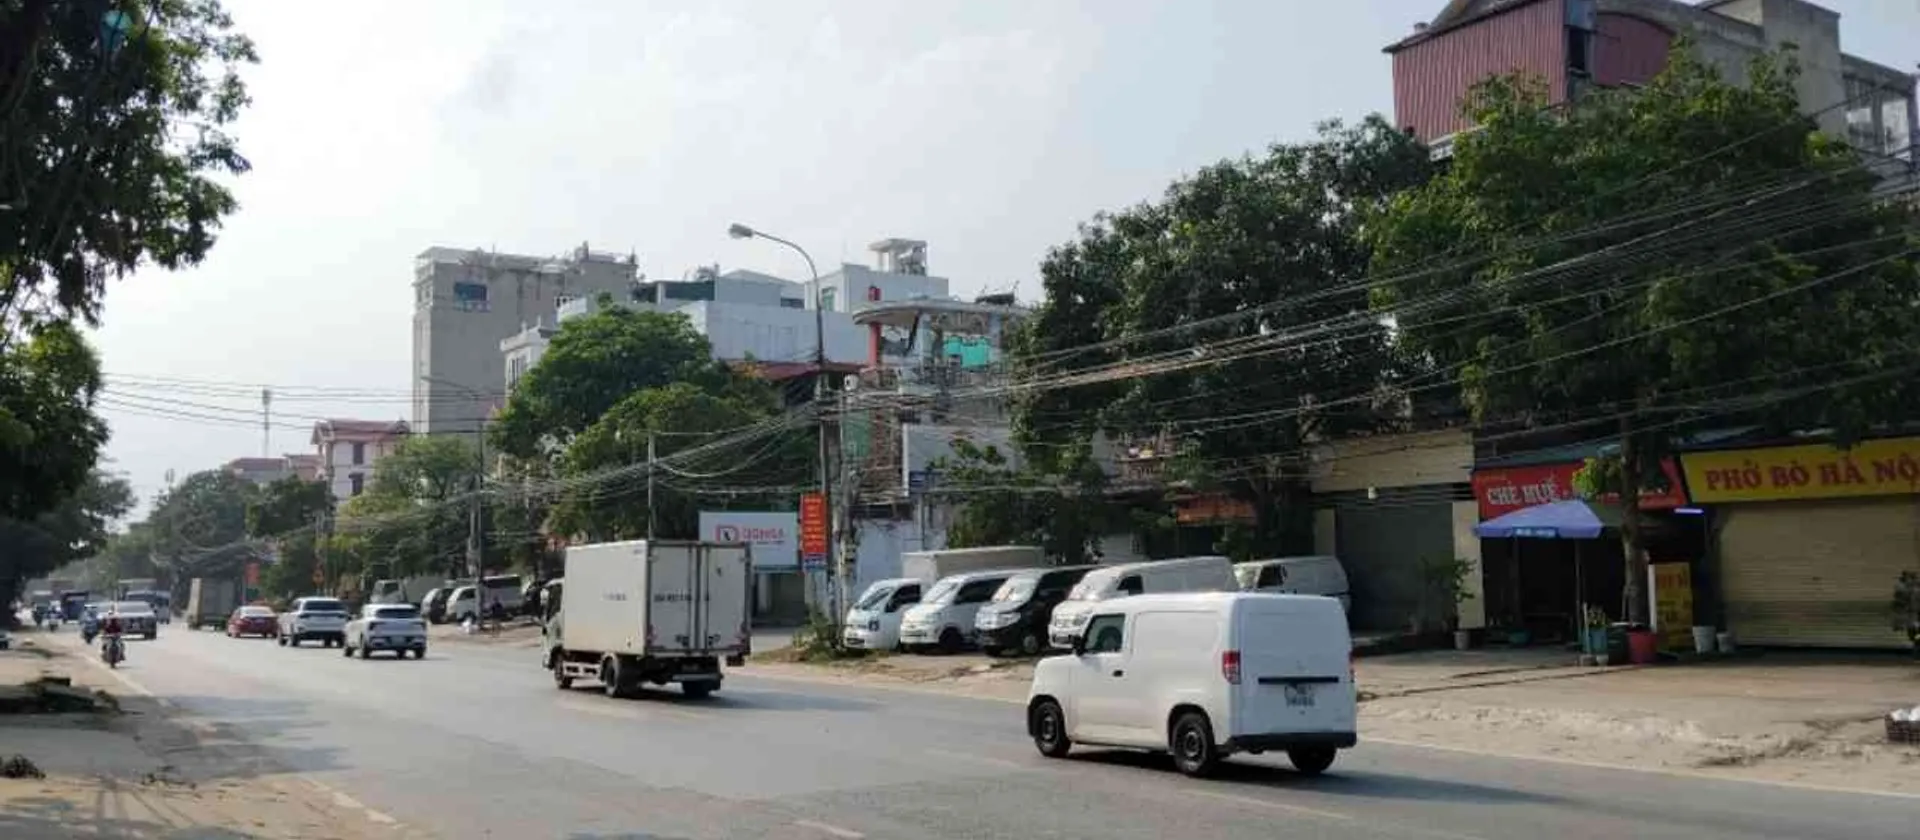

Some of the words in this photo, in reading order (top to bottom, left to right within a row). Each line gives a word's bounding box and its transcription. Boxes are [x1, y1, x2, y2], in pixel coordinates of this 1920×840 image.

[1704, 458, 1763, 491] PHỞ
[1769, 459, 1810, 489] BÒ
[1817, 457, 1865, 486] HÀ
[1871, 452, 1920, 492] NỘ
[1487, 480, 1521, 505] CHÈ
